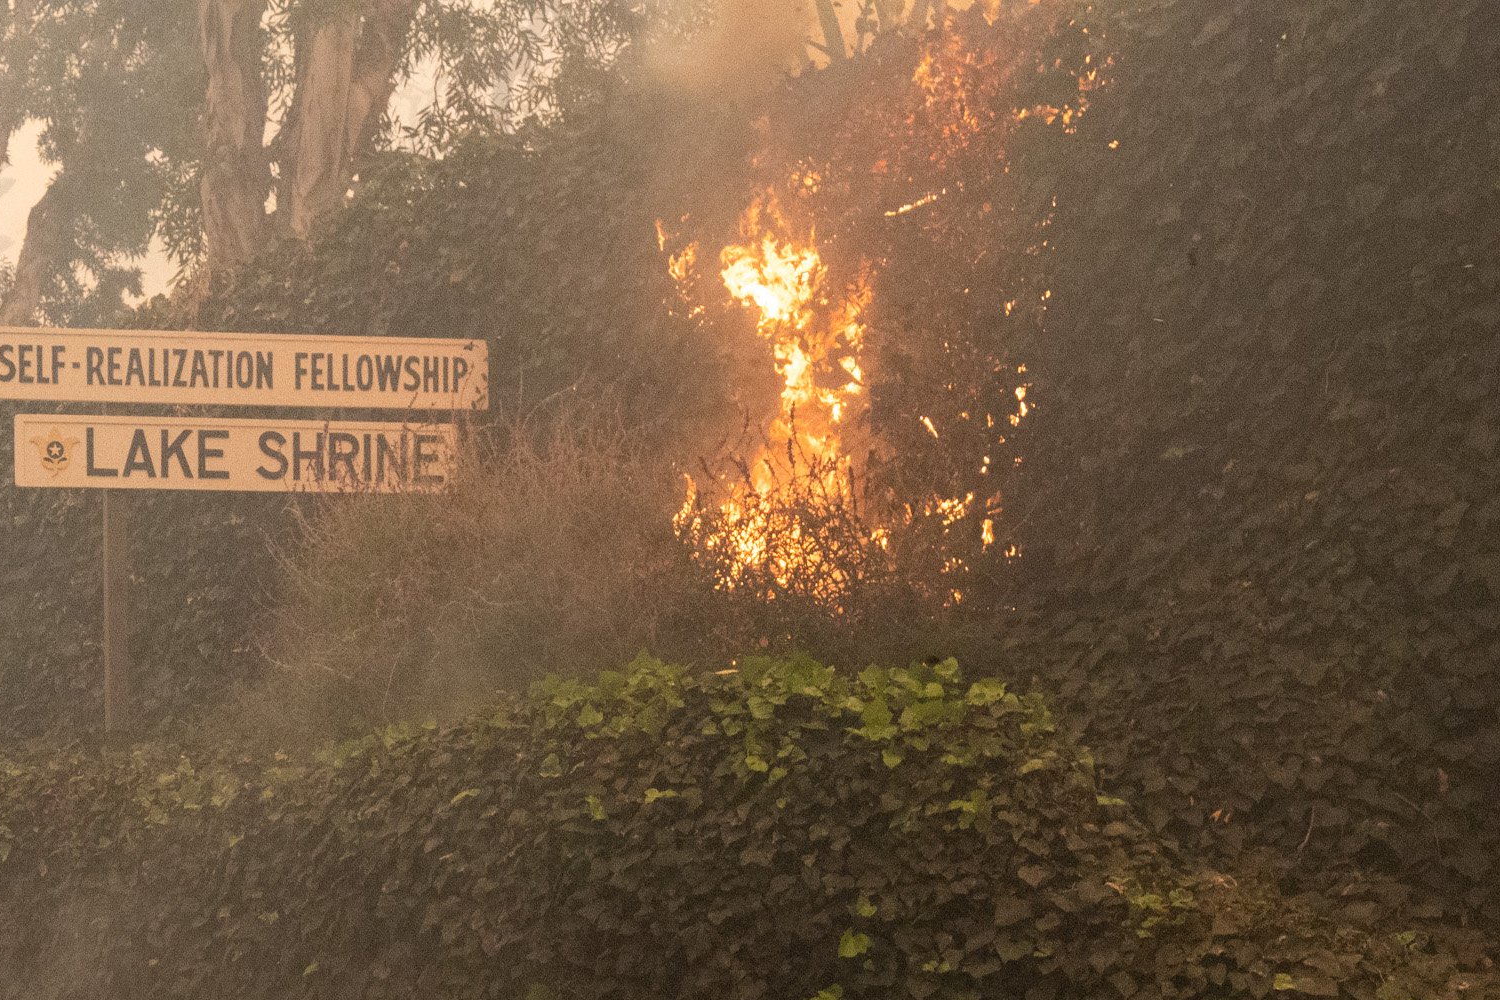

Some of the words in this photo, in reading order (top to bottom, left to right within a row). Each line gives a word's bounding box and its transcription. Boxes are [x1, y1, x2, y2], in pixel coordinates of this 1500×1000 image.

[294, 351, 469, 395] FELLOWSHIP
[85, 426, 231, 480] LAKE
[255, 431, 446, 485] SHRINE
